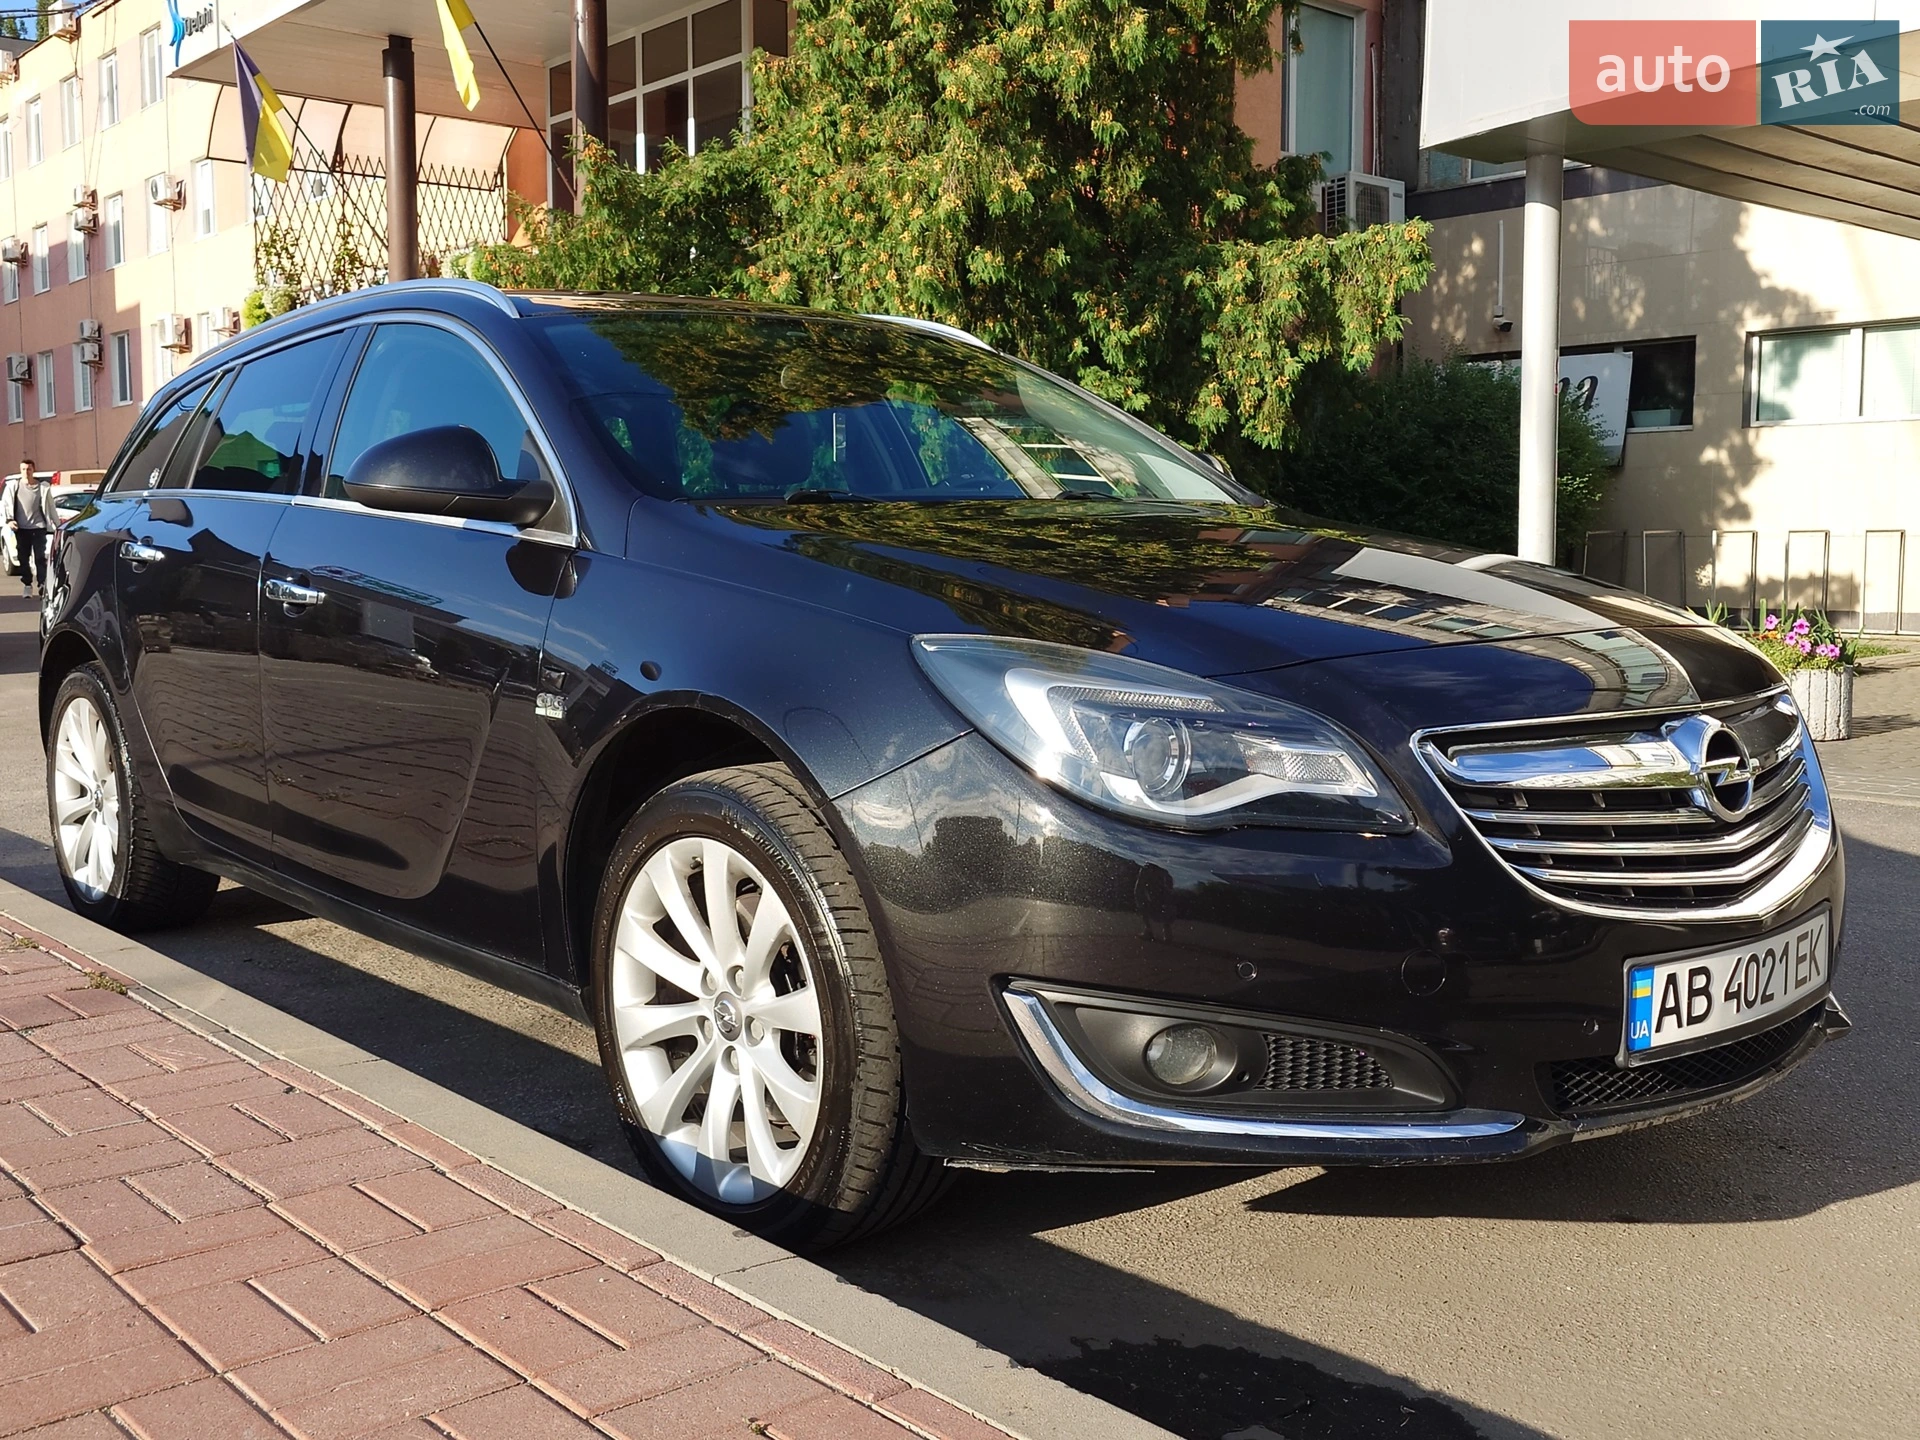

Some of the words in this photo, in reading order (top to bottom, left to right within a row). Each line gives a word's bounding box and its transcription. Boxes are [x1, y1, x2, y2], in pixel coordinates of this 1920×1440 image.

[1654, 965, 1713, 1034] AB
[1723, 941, 1791, 1015] 4021
[1794, 923, 1825, 991] EK
[1630, 1019, 1650, 1040] UA
